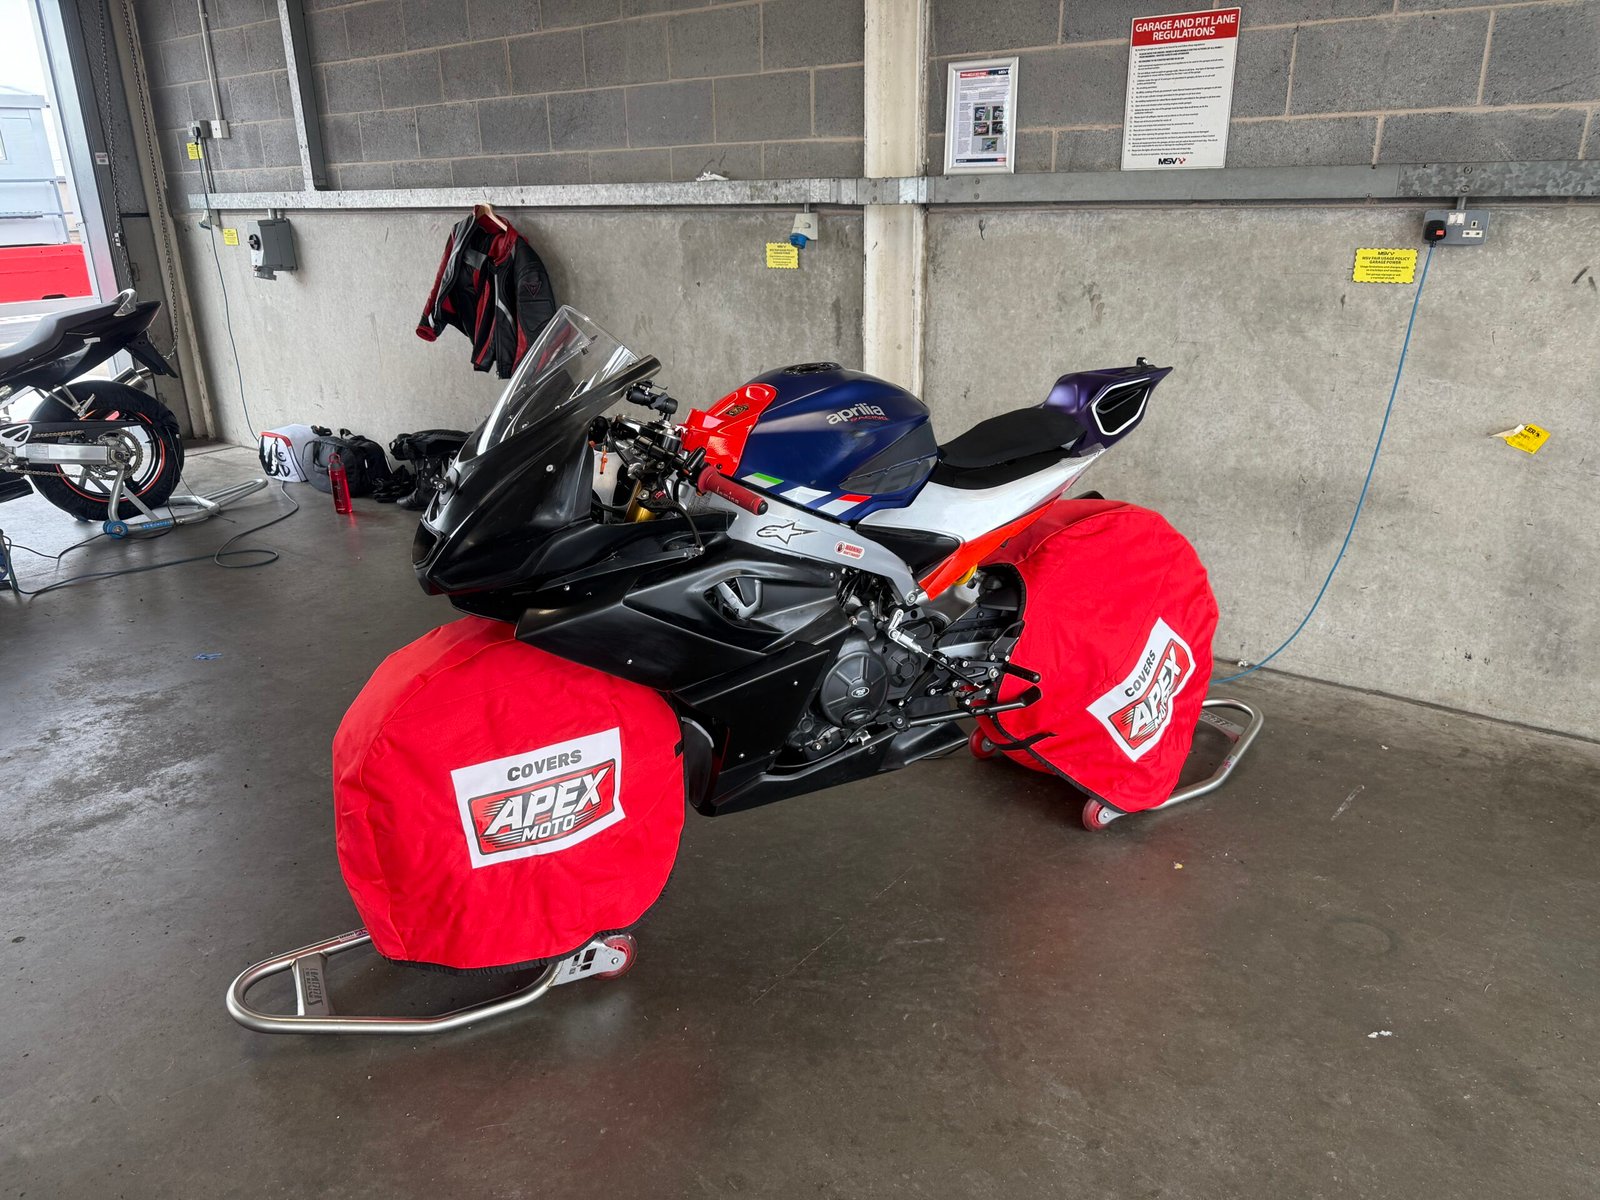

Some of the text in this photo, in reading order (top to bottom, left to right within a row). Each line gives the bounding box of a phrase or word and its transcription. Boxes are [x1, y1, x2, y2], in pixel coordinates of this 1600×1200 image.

[1135, 13, 1237, 33] GARAGE AND PIT LANE
[1152, 26, 1216, 41] REGULATIONS
[1158, 157, 1178, 165] MSV
[826, 402, 886, 425] aprilia
[1124, 649, 1156, 697] COVERS
[1129, 645, 1182, 739] APEX
[506, 749, 582, 782] COVERS
[484, 764, 612, 836] APEX
[521, 814, 575, 842] MOTO
